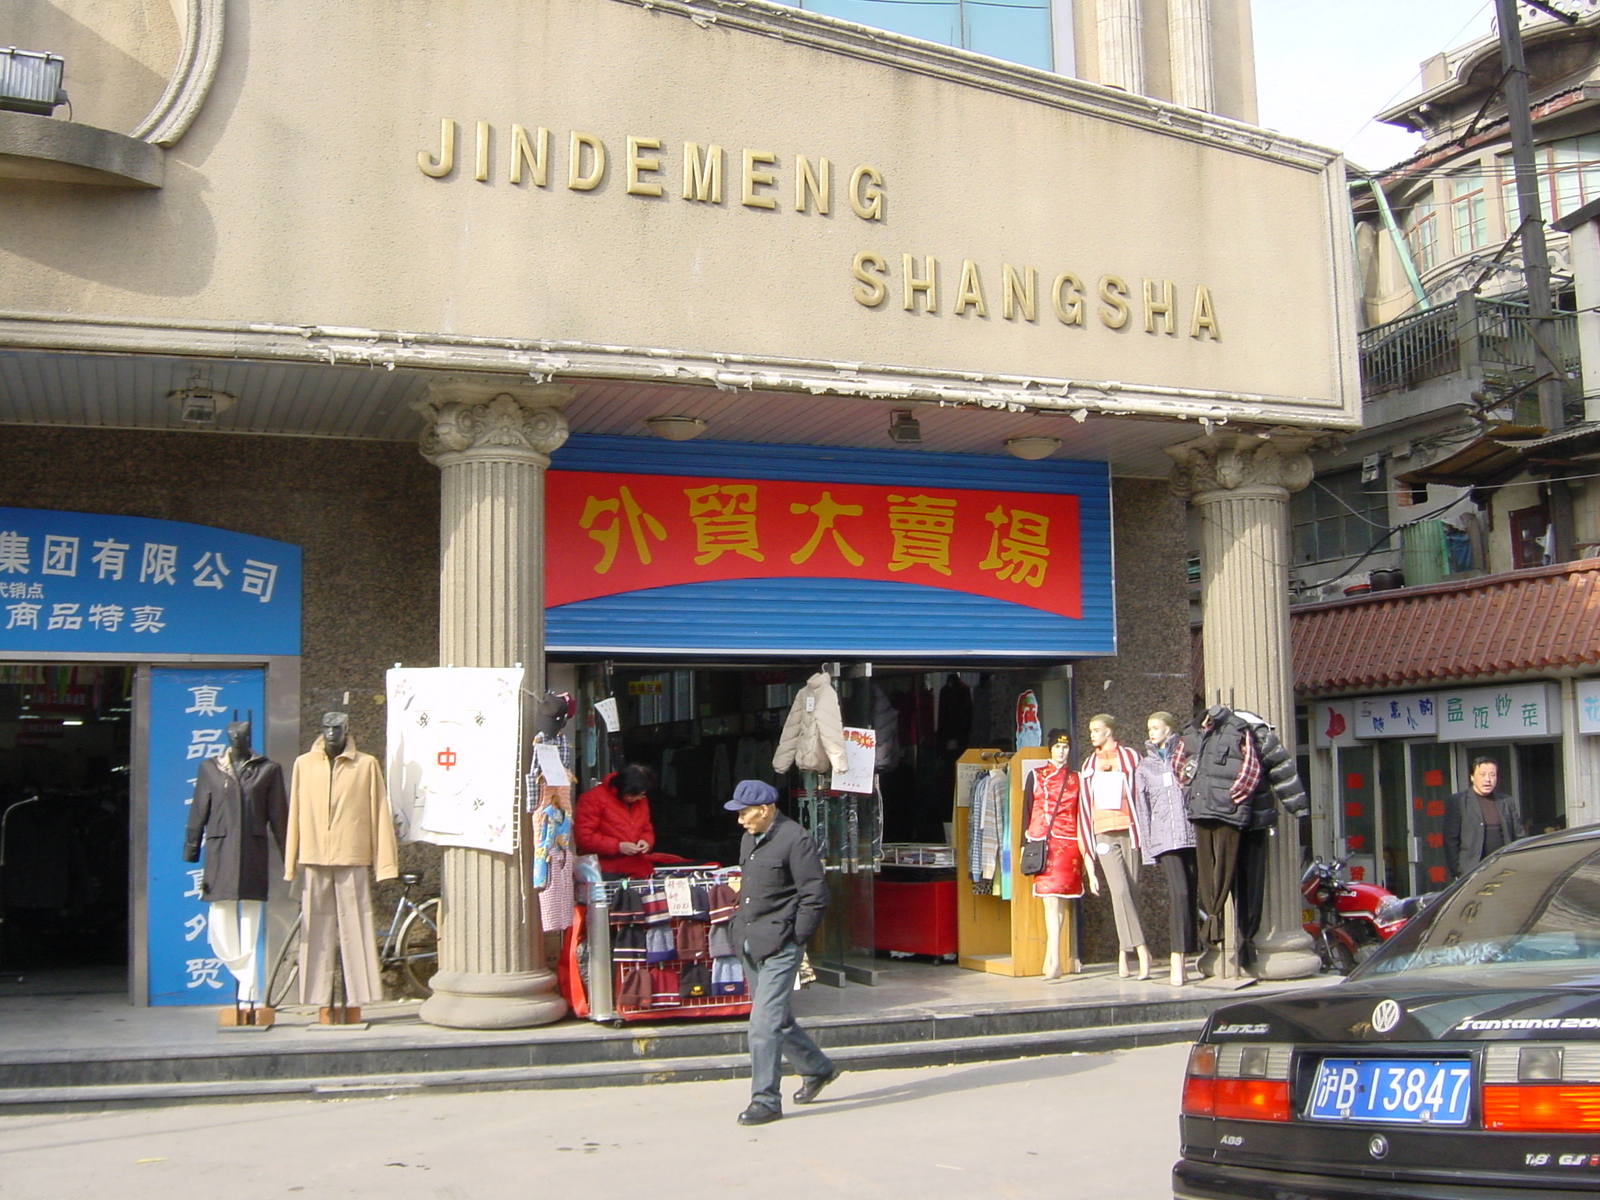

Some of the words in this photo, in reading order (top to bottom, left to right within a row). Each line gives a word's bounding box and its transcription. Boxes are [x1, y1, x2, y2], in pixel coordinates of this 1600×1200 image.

[417, 117, 883, 220] JINDEMENG
[852, 250, 1221, 340] SHANGSHA
[0, 530, 278, 603] 集团有限公司
[578, 485, 1051, 588] 外貿大賣場
[437, 746, 456, 771] 中
